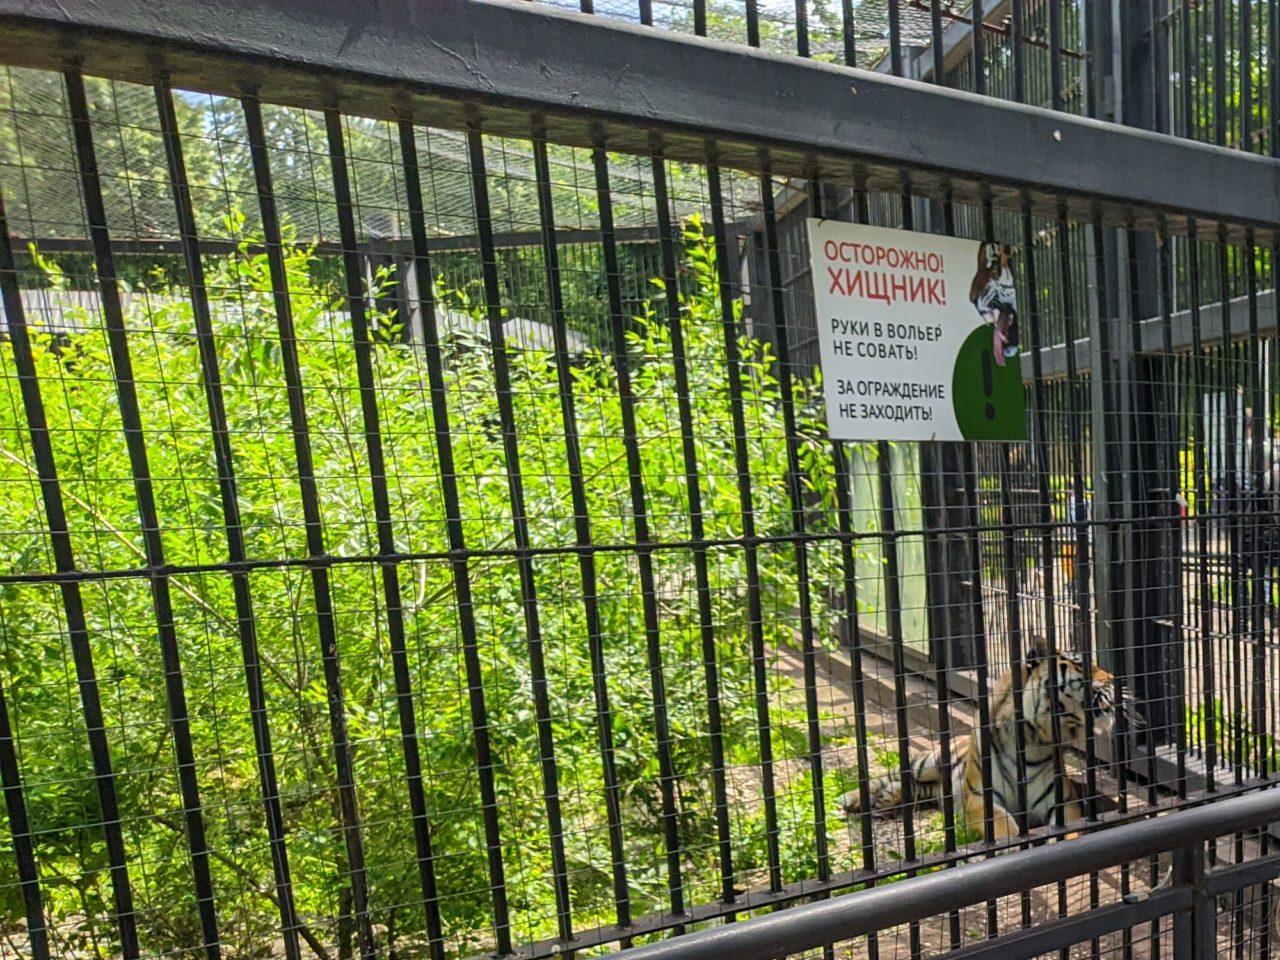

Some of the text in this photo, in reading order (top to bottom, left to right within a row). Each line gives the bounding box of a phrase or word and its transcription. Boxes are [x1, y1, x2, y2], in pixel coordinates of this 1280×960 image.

[824, 240, 944, 273] ОСТОРОЖНО!
[827, 266, 947, 306] ХИЩНИК!
[831, 318, 942, 342] РУКИ В ВОЛЬЕР
[833, 341, 918, 360] НЕ СОВАТЬ!
[837, 379, 946, 400] ЗА ОГРАЖДЕНИЕ
[839, 403, 933, 423] НЕ ЗАХОДИТЬ!
